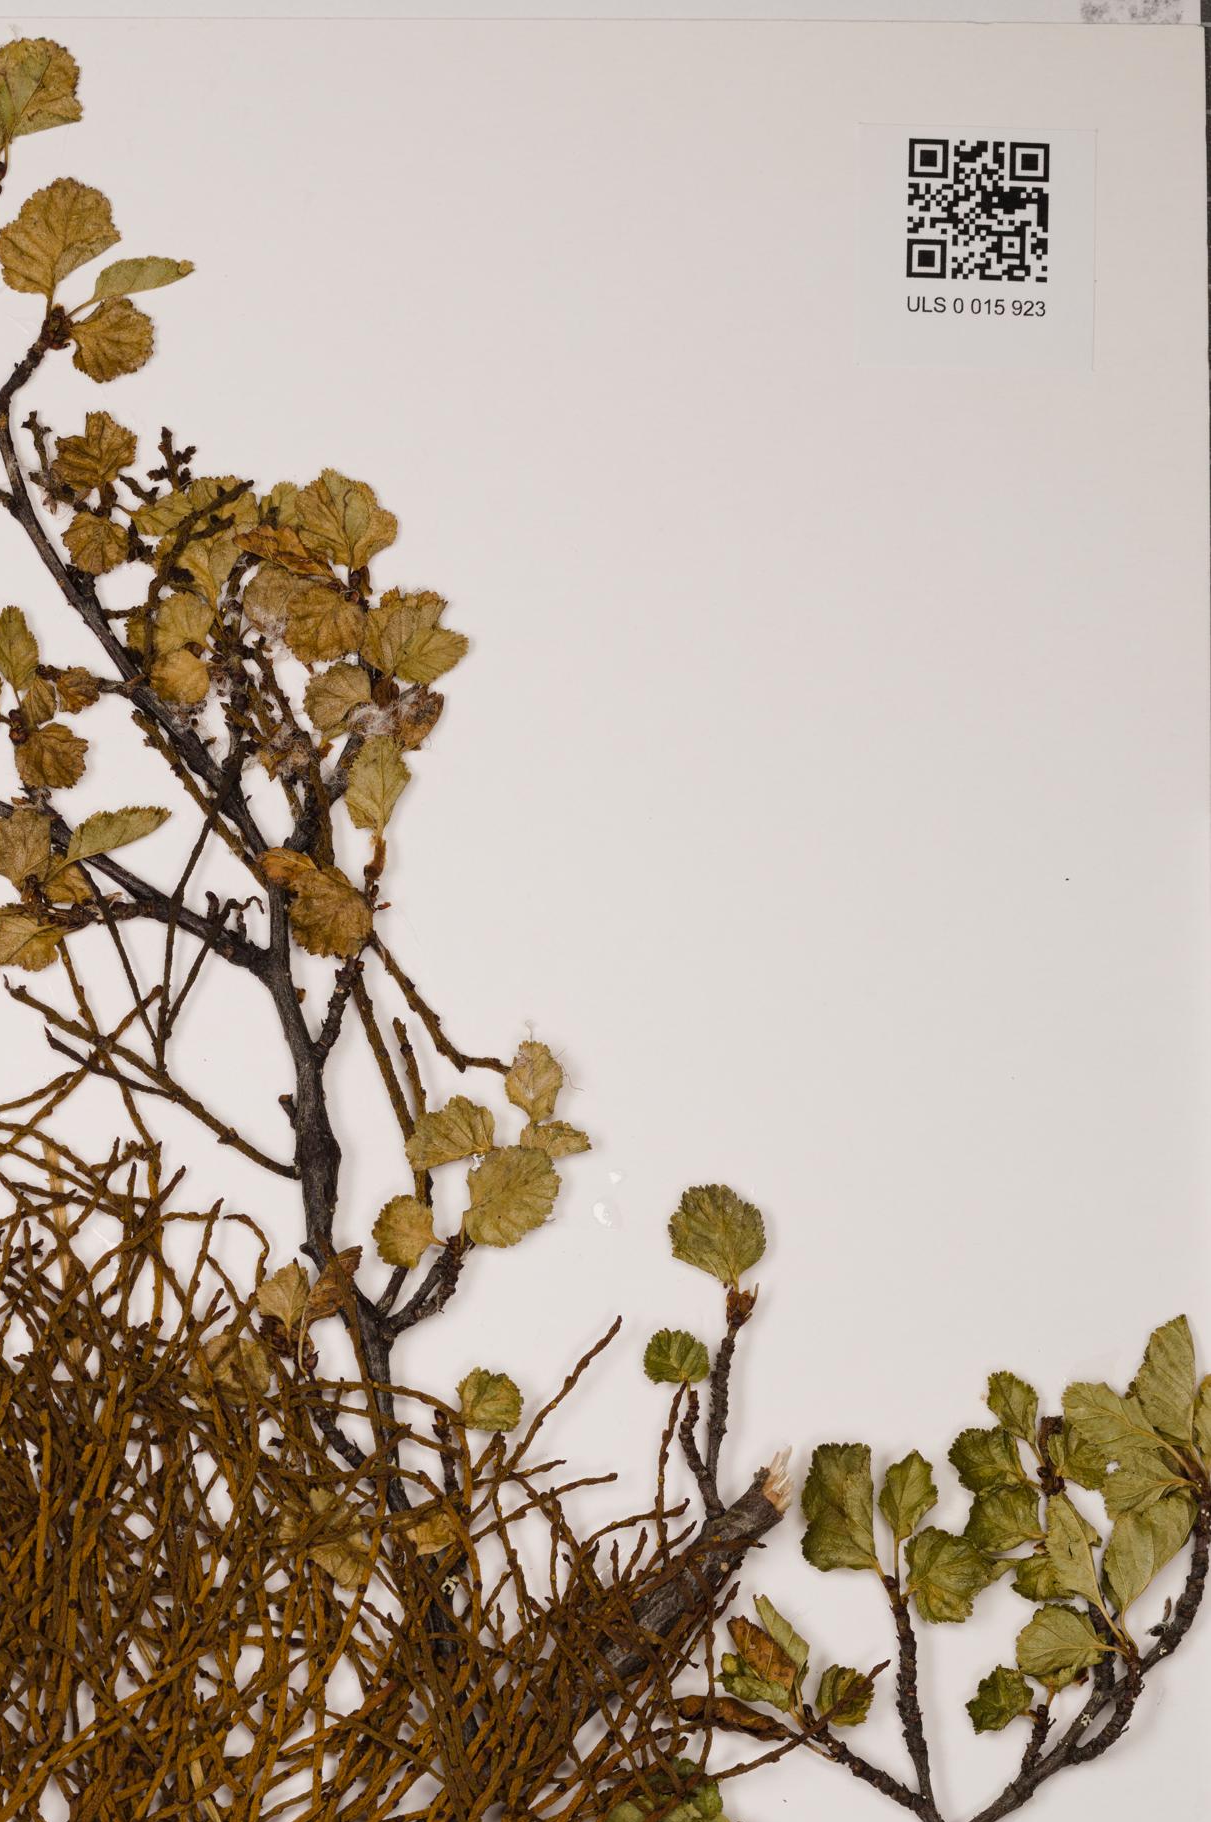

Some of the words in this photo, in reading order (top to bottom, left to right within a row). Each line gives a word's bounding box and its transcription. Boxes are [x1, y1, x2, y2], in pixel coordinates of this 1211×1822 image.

[907, 295, 947, 314] ULS
[952, 297, 964, 314] 0
[970, 298, 1006, 316] 015
[1011, 299, 1046, 317] 923
